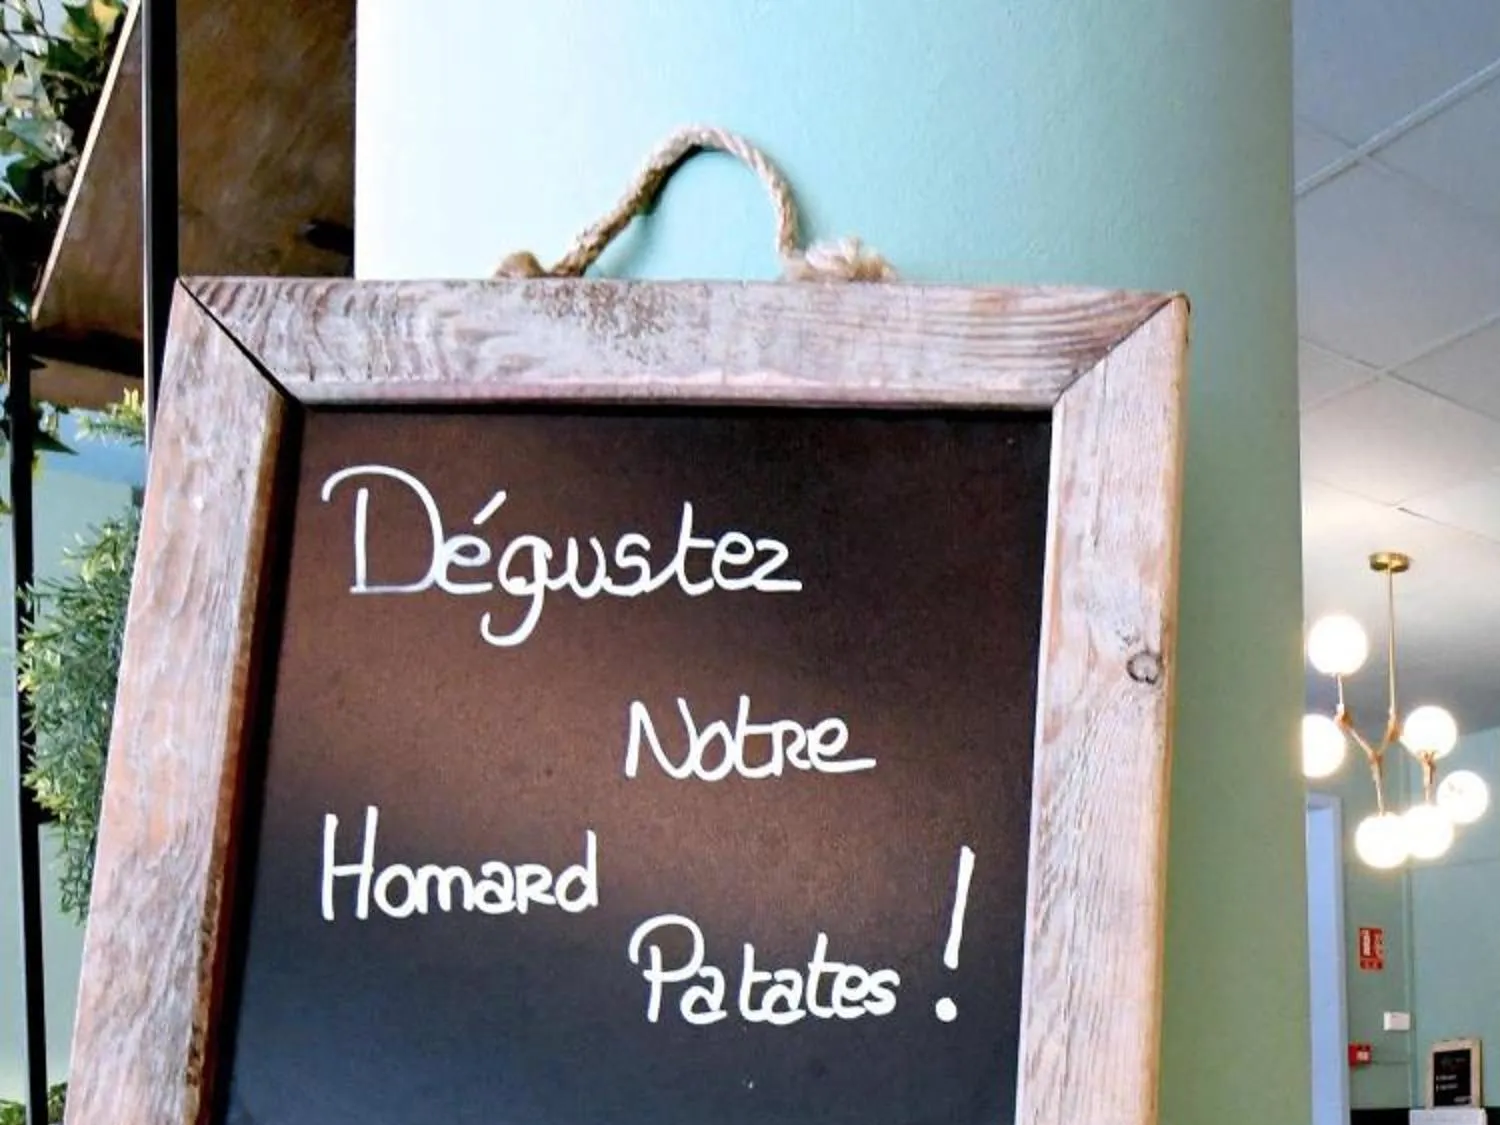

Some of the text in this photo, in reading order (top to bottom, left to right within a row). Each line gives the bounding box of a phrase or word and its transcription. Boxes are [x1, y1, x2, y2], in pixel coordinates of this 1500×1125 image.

[321, 465, 803, 647] Dégustez
[626, 694, 876, 782] Notre
[320, 805, 599, 921] Homard
[628, 913, 902, 1026] Patates
